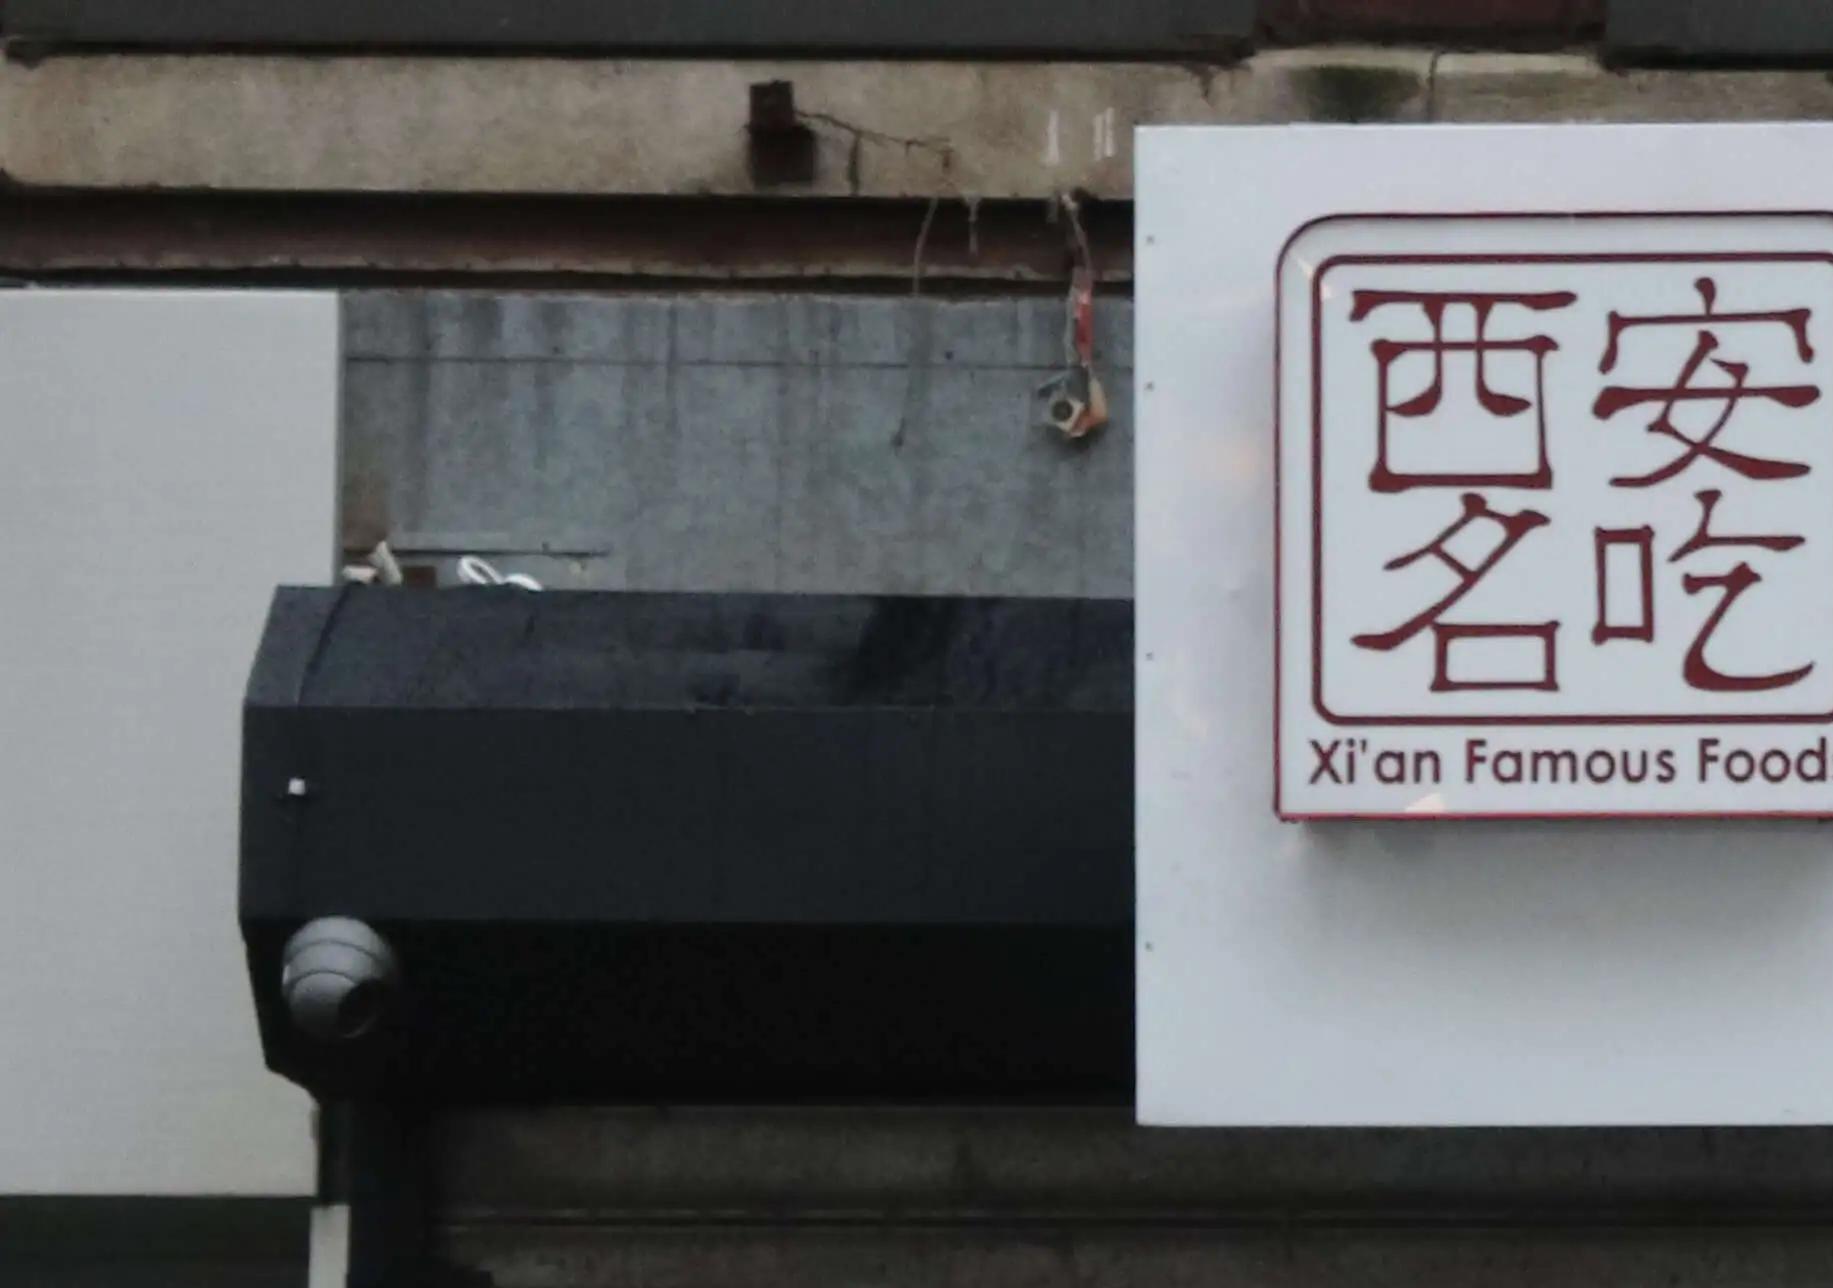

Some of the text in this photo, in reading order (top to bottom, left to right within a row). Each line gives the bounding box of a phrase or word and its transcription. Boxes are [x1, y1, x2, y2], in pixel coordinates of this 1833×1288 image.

[1348, 276, 1822, 494] 西安
[1349, 488, 1816, 694] 名吃
[1308, 737, 1442, 787] Xi'an
[1464, 738, 1677, 786] Famous
